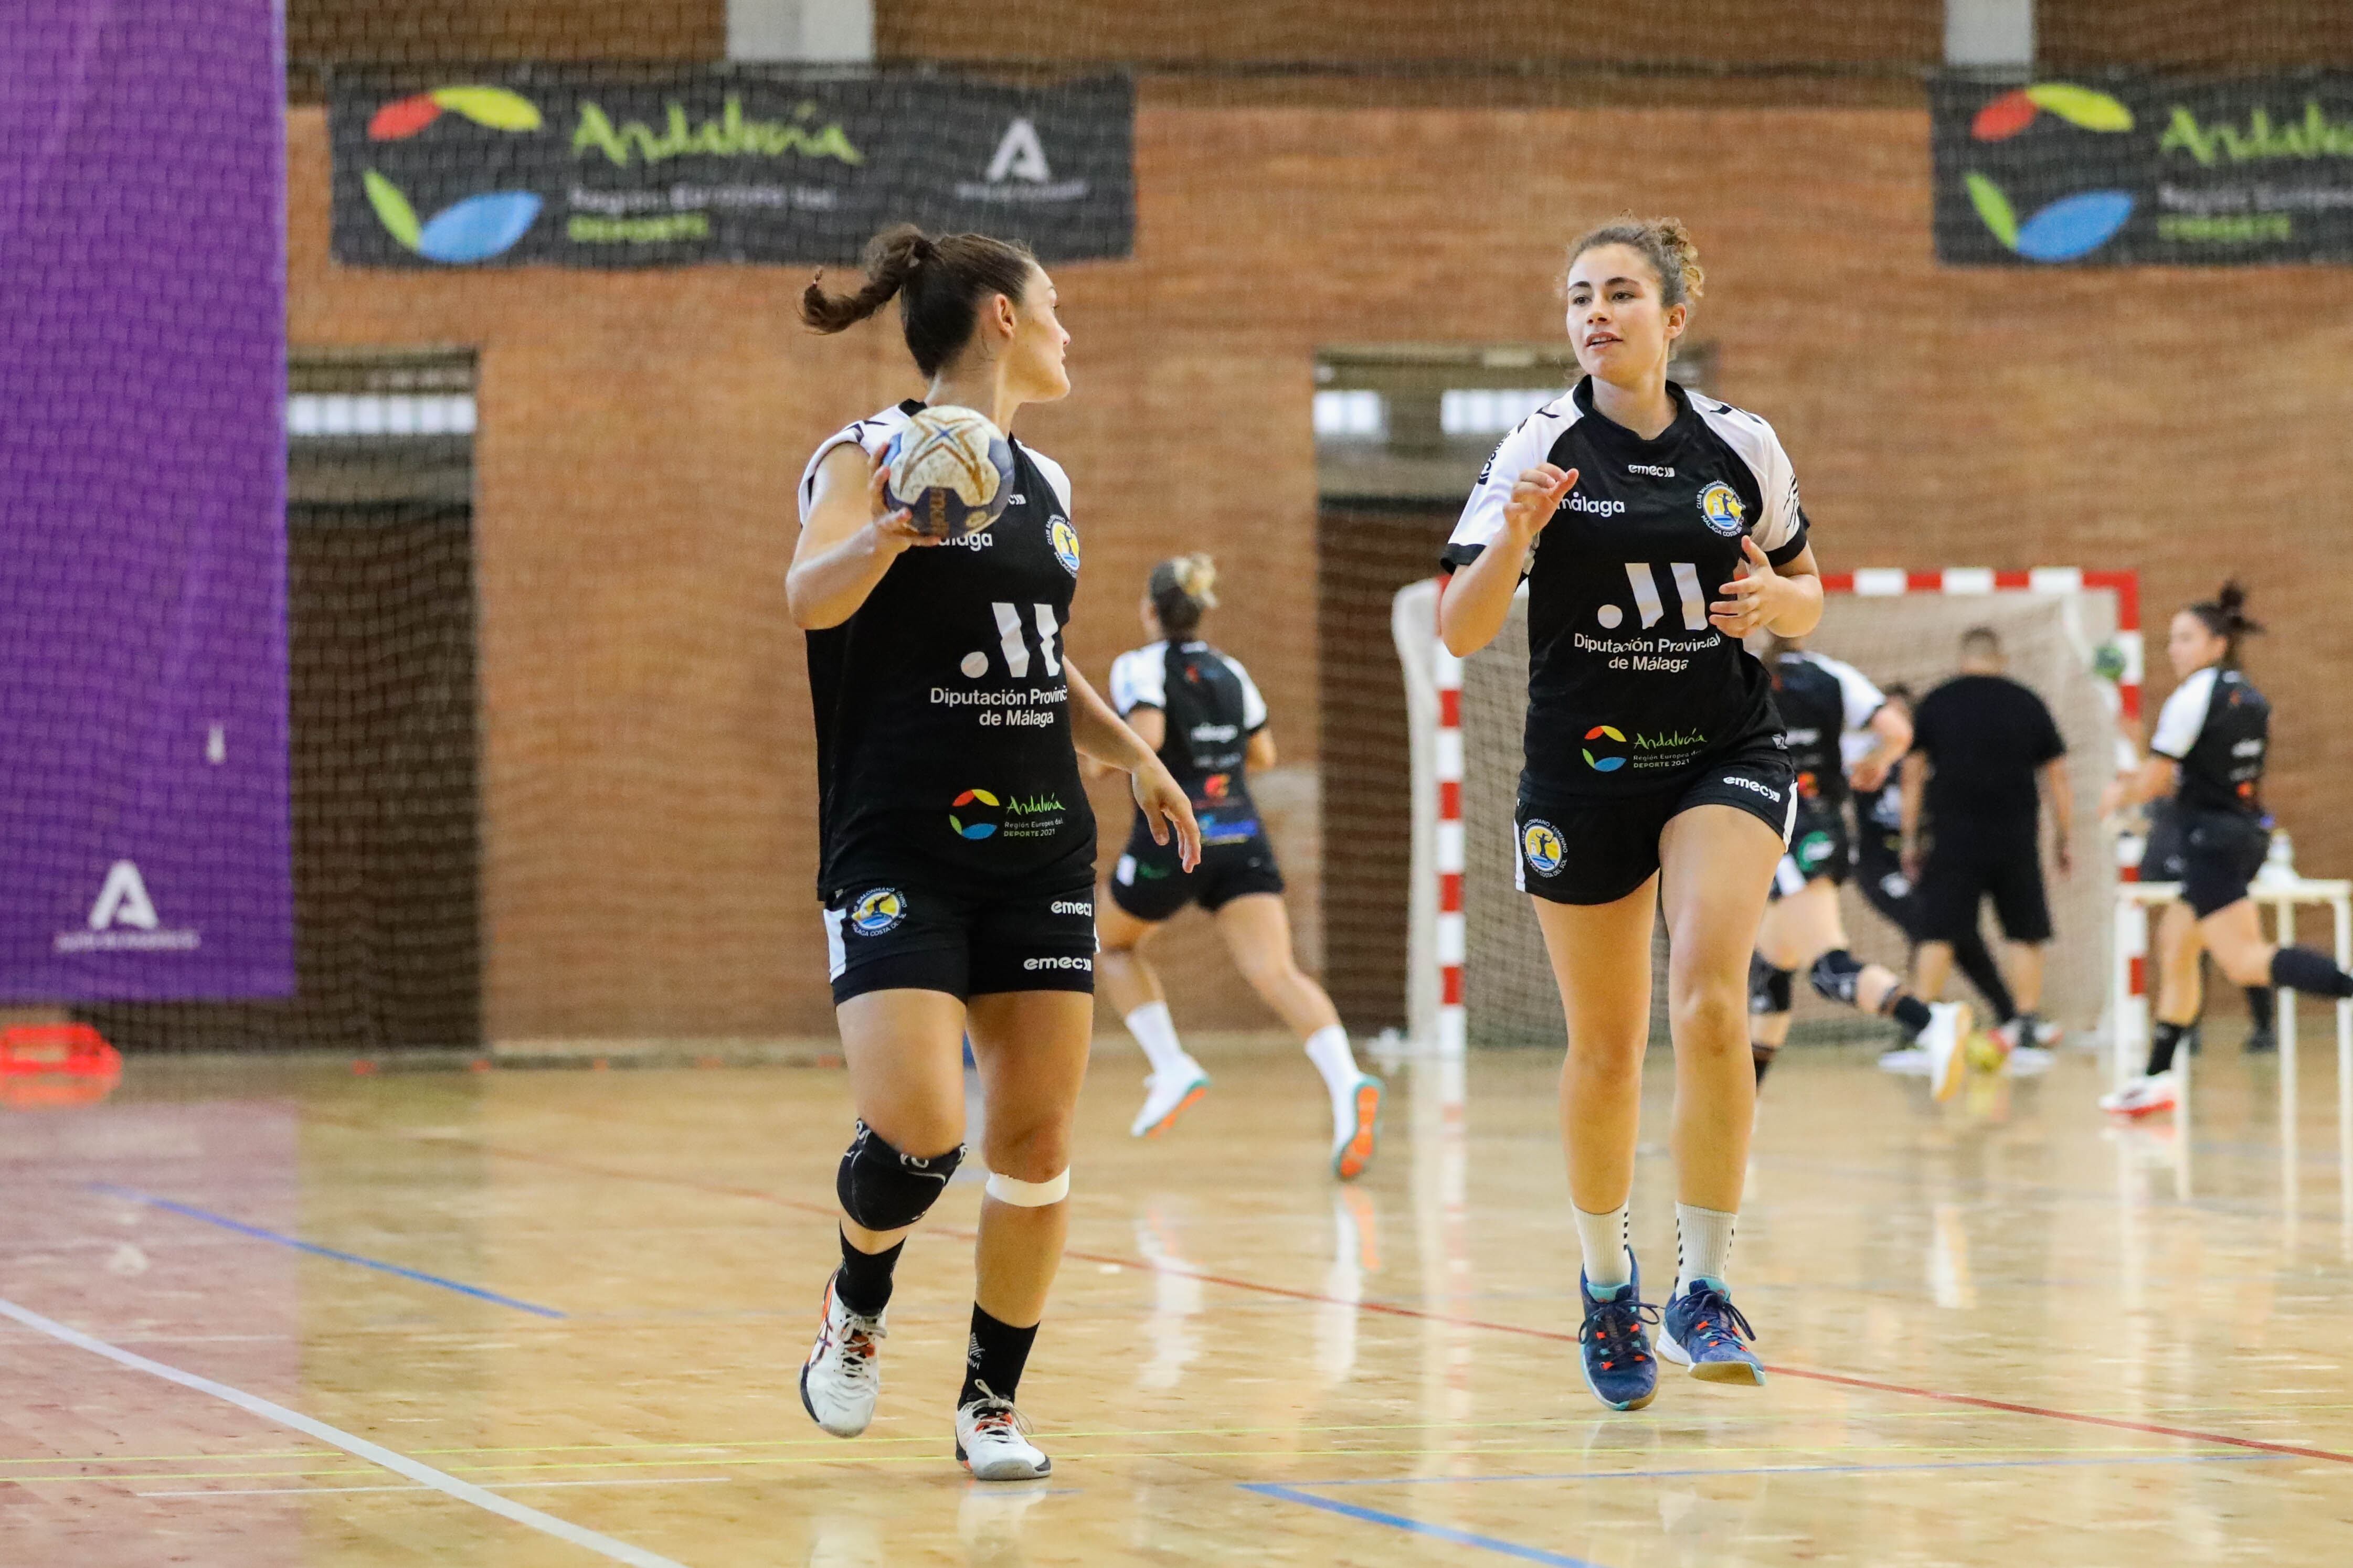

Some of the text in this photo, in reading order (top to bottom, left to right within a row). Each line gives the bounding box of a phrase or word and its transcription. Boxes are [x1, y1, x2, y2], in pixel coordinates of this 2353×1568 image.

[1574, 632, 1654, 654] Diputación
[1608, 656, 1689, 673] de Málaga
[930, 688, 1026, 707] Diputación
[979, 709, 1054, 728] de Málaga
[1633, 727, 1708, 750] Andalucía
[1004, 821, 1030, 829] Región
[1040, 828, 1055, 837] 2021
[870, 926, 891, 936] COSTA
[1023, 956, 1083, 970] emec
